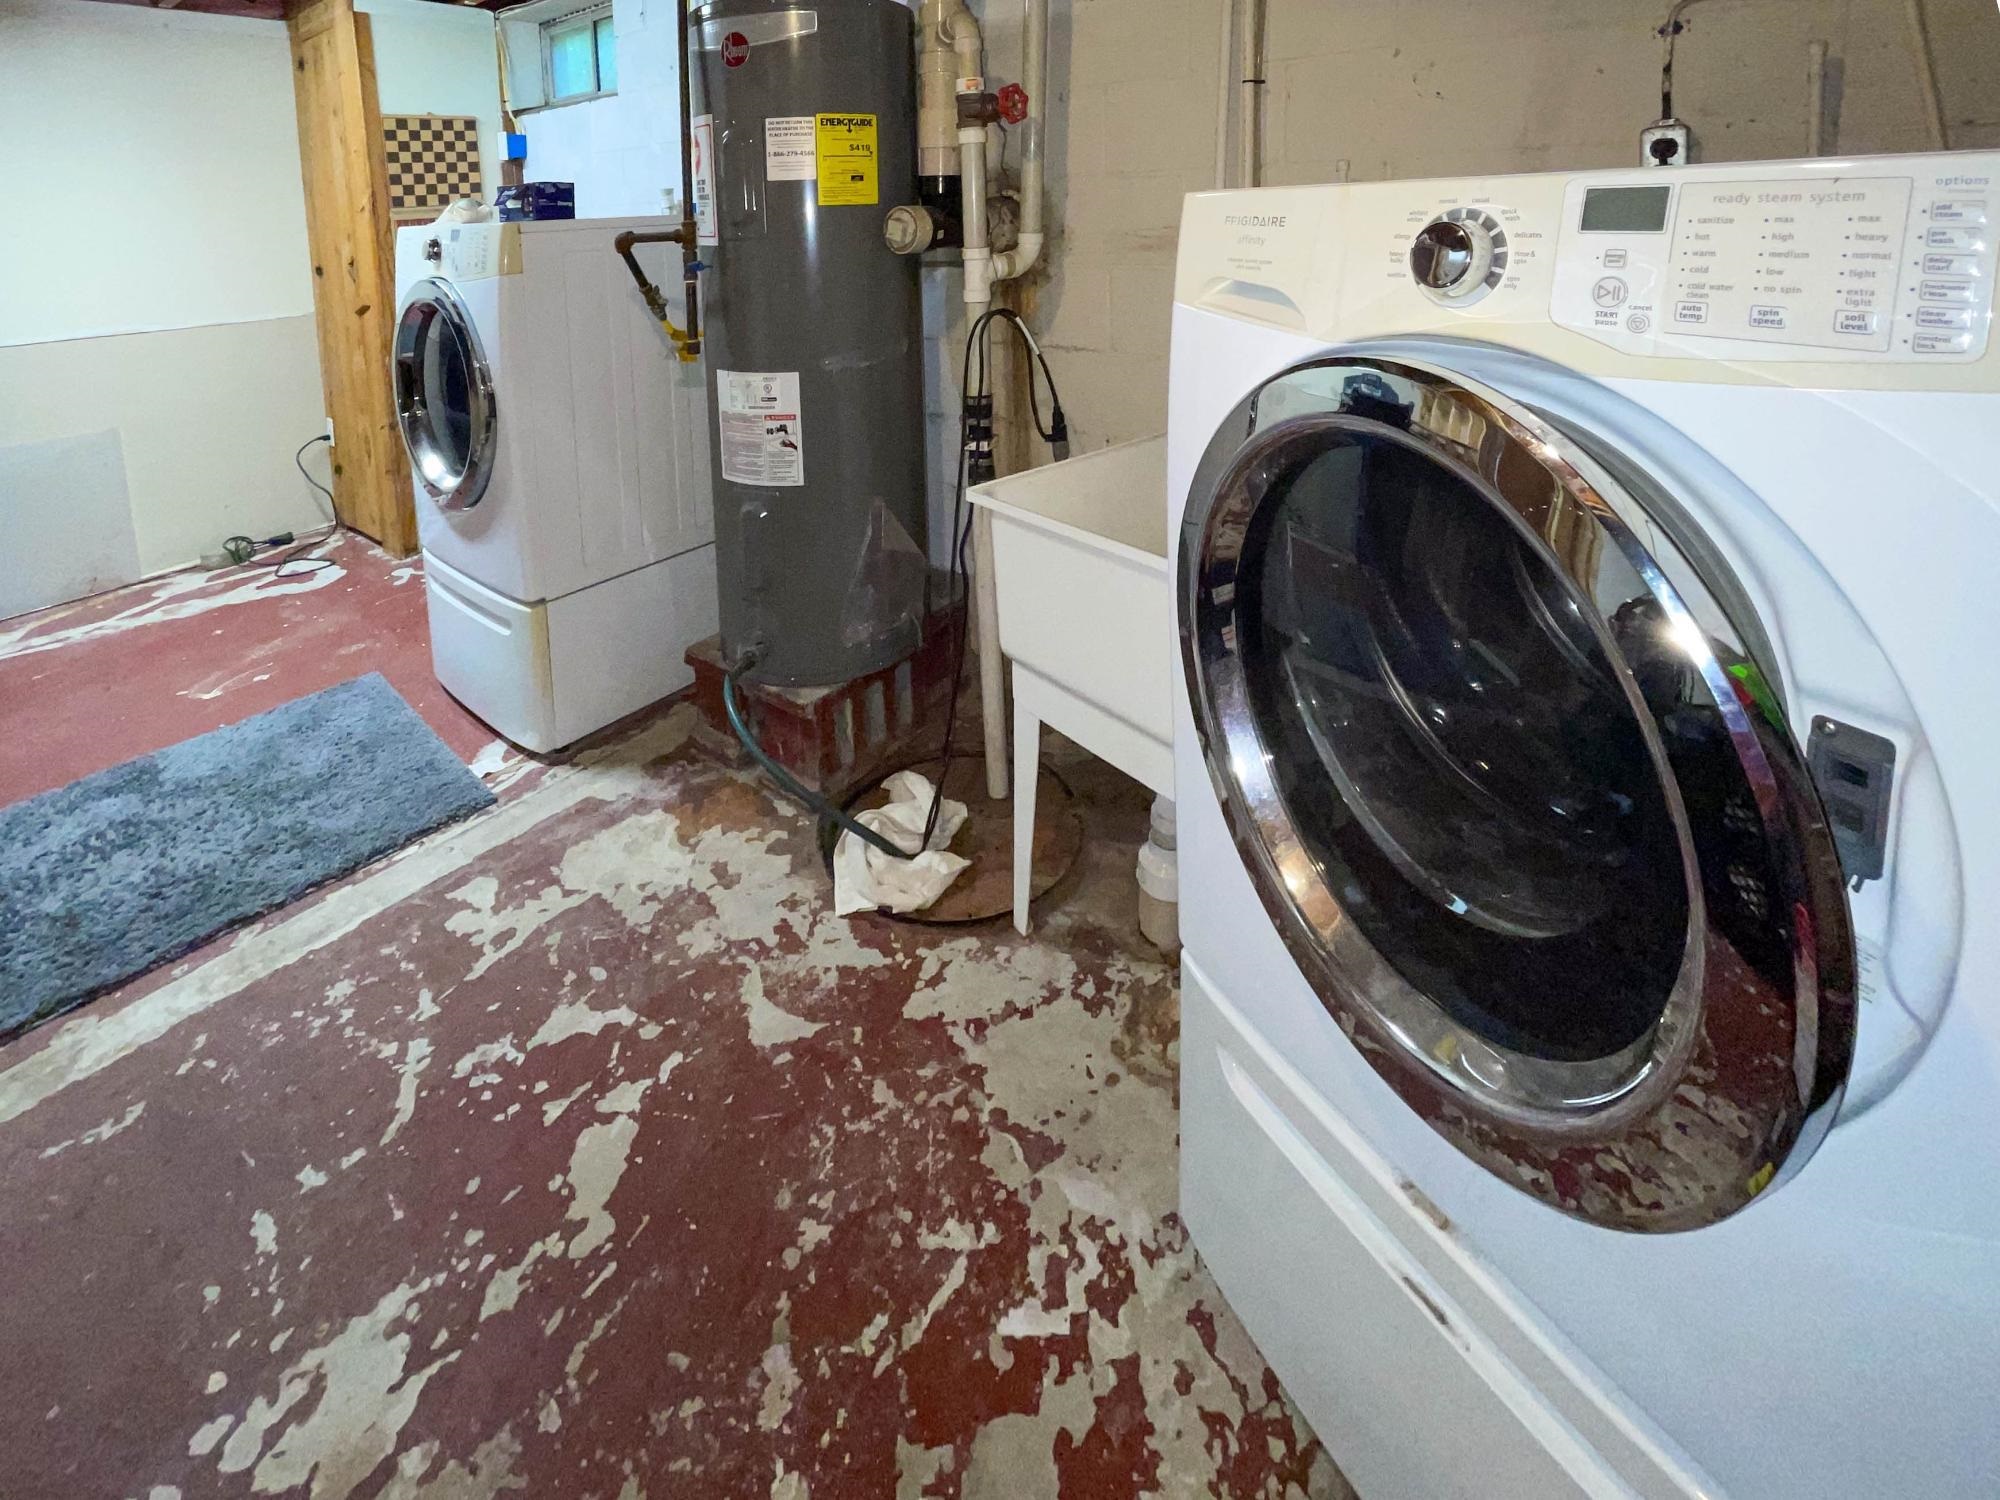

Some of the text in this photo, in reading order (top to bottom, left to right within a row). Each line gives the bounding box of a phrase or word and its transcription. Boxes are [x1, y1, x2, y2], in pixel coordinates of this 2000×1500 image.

[820, 118, 873, 127] ENERGYGUIDE
[1935, 176, 1990, 186] options
[1713, 190, 1866, 205] ready steam system
[1224, 215, 1287, 227] FRIGIDAIRE
[1697, 216, 1735, 224] sanitize
[1774, 216, 1795, 224] max
[1857, 214, 1881, 223] max
[1694, 232, 1710, 241] hot
[1771, 232, 1795, 242] high
[1854, 233, 1889, 243] heavy
[1768, 251, 1810, 259] medium
[1851, 251, 1892, 260] normal
[1689, 265, 1710, 274] cold
[1766, 268, 1785, 276] low
[1848, 269, 1876, 278] light
[1687, 282, 1734, 291] cold water
[1763, 285, 1802, 294] no spin
[1686, 291, 1709, 299] clean
[1846, 288, 1875, 296] extra
[1845, 297, 1873, 307] light
[1628, 304, 1653, 312] cancel
[1681, 304, 1702, 313] auto
[1595, 310, 1618, 319] START
[1679, 312, 1703, 322] temp
[1757, 308, 1780, 318] spin
[1844, 312, 1866, 322] soil
[1594, 318, 1618, 327] pause
[1752, 316, 1784, 326] speed
[1840, 321, 1868, 331] level
